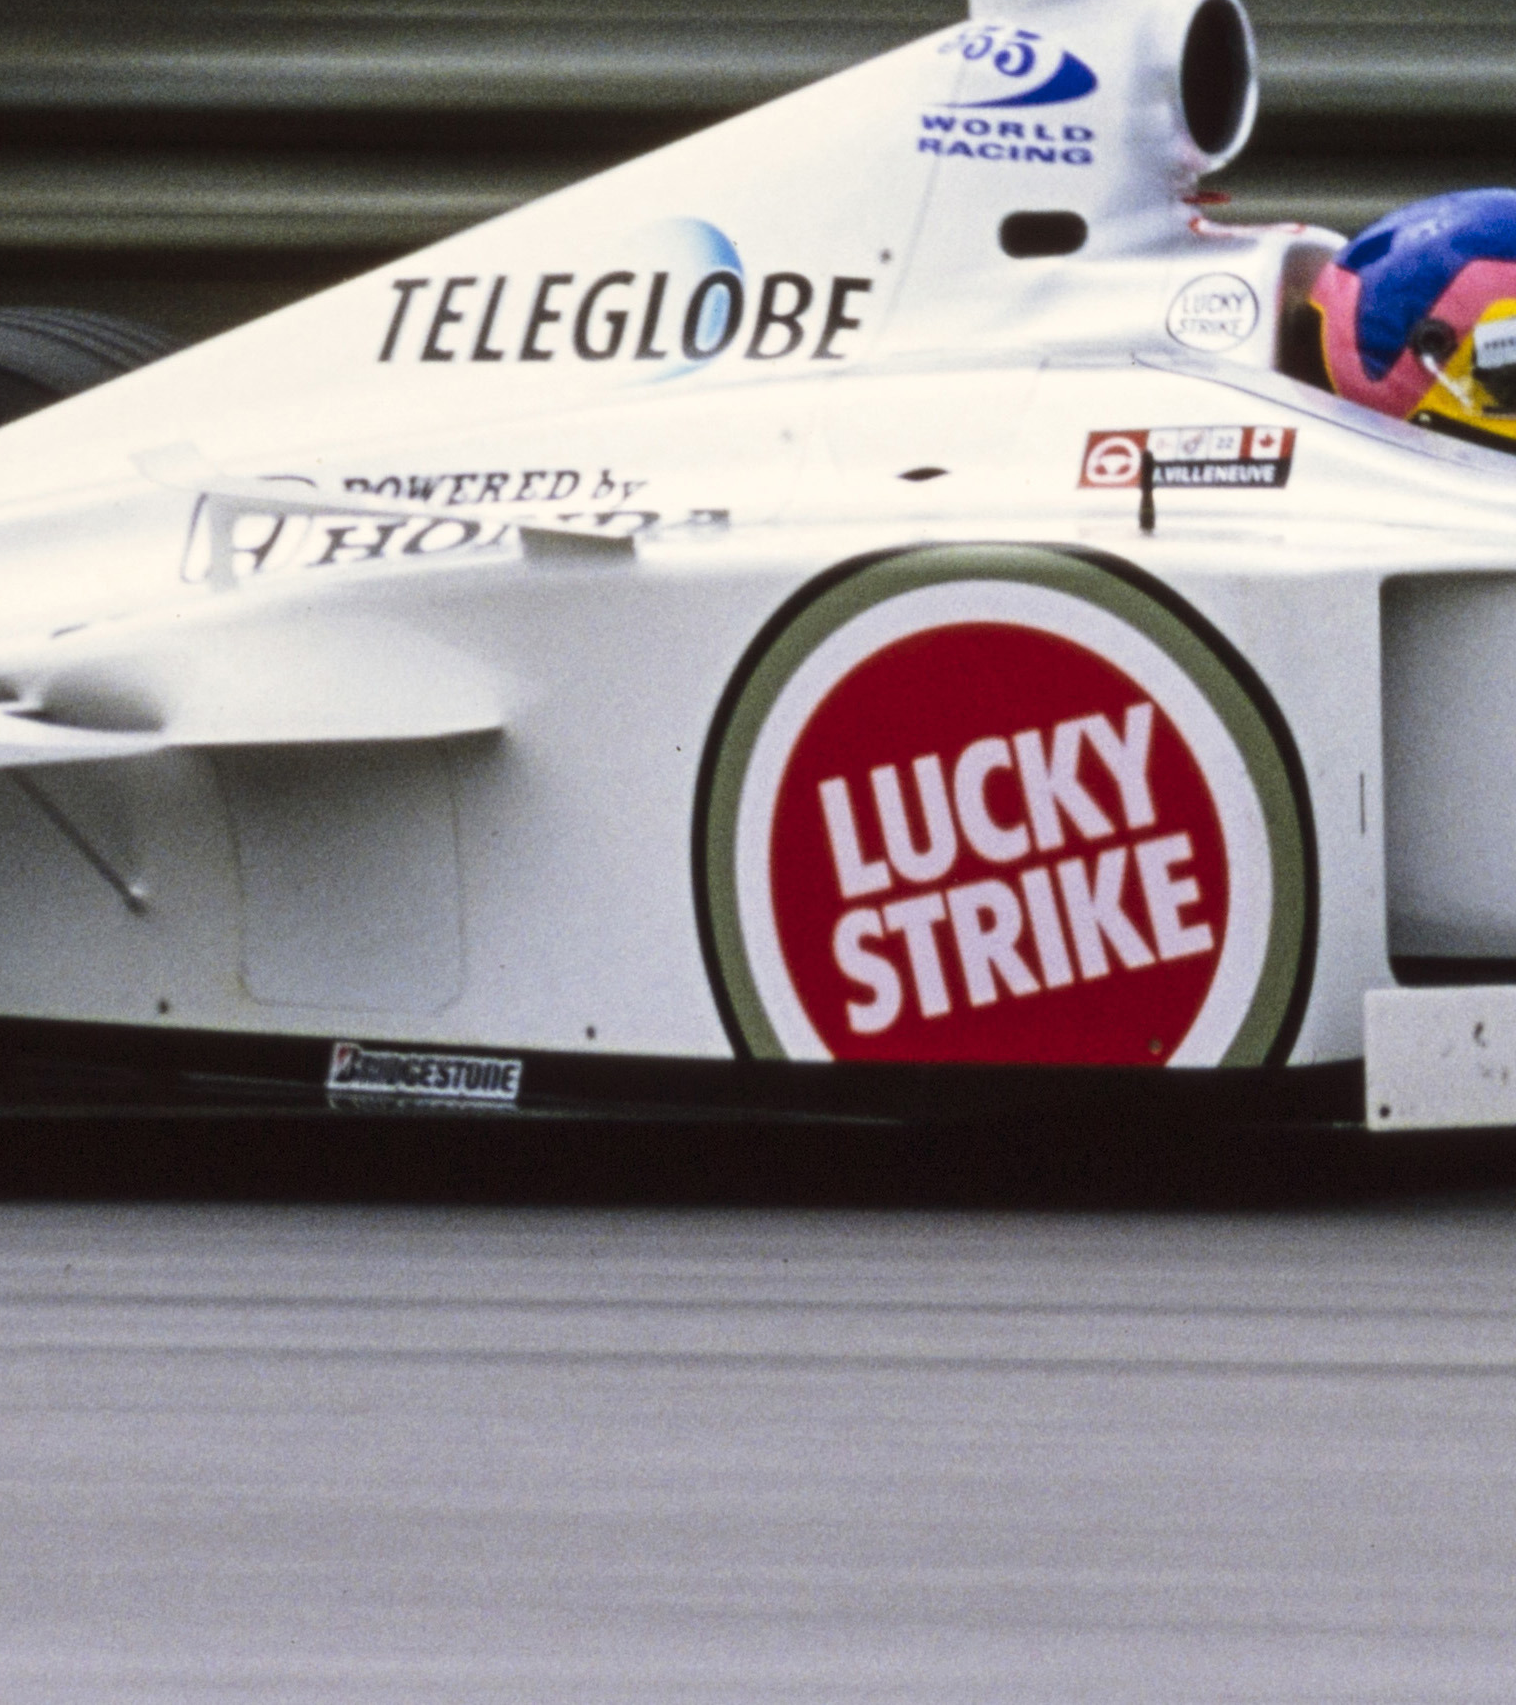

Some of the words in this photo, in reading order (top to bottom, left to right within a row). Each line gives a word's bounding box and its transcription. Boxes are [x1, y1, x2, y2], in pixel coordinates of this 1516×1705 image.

[921, 114, 1094, 143] WORLD
[917, 137, 1094, 166] RACING
[377, 270, 874, 362] TELEGLOBE
[1182, 292, 1248, 315] LUCKY
[1175, 317, 1244, 336] STRIKE
[591, 468, 648, 508] by
[817, 699, 1158, 900] LUCKY
[831, 829, 1216, 1035] STRIKE
